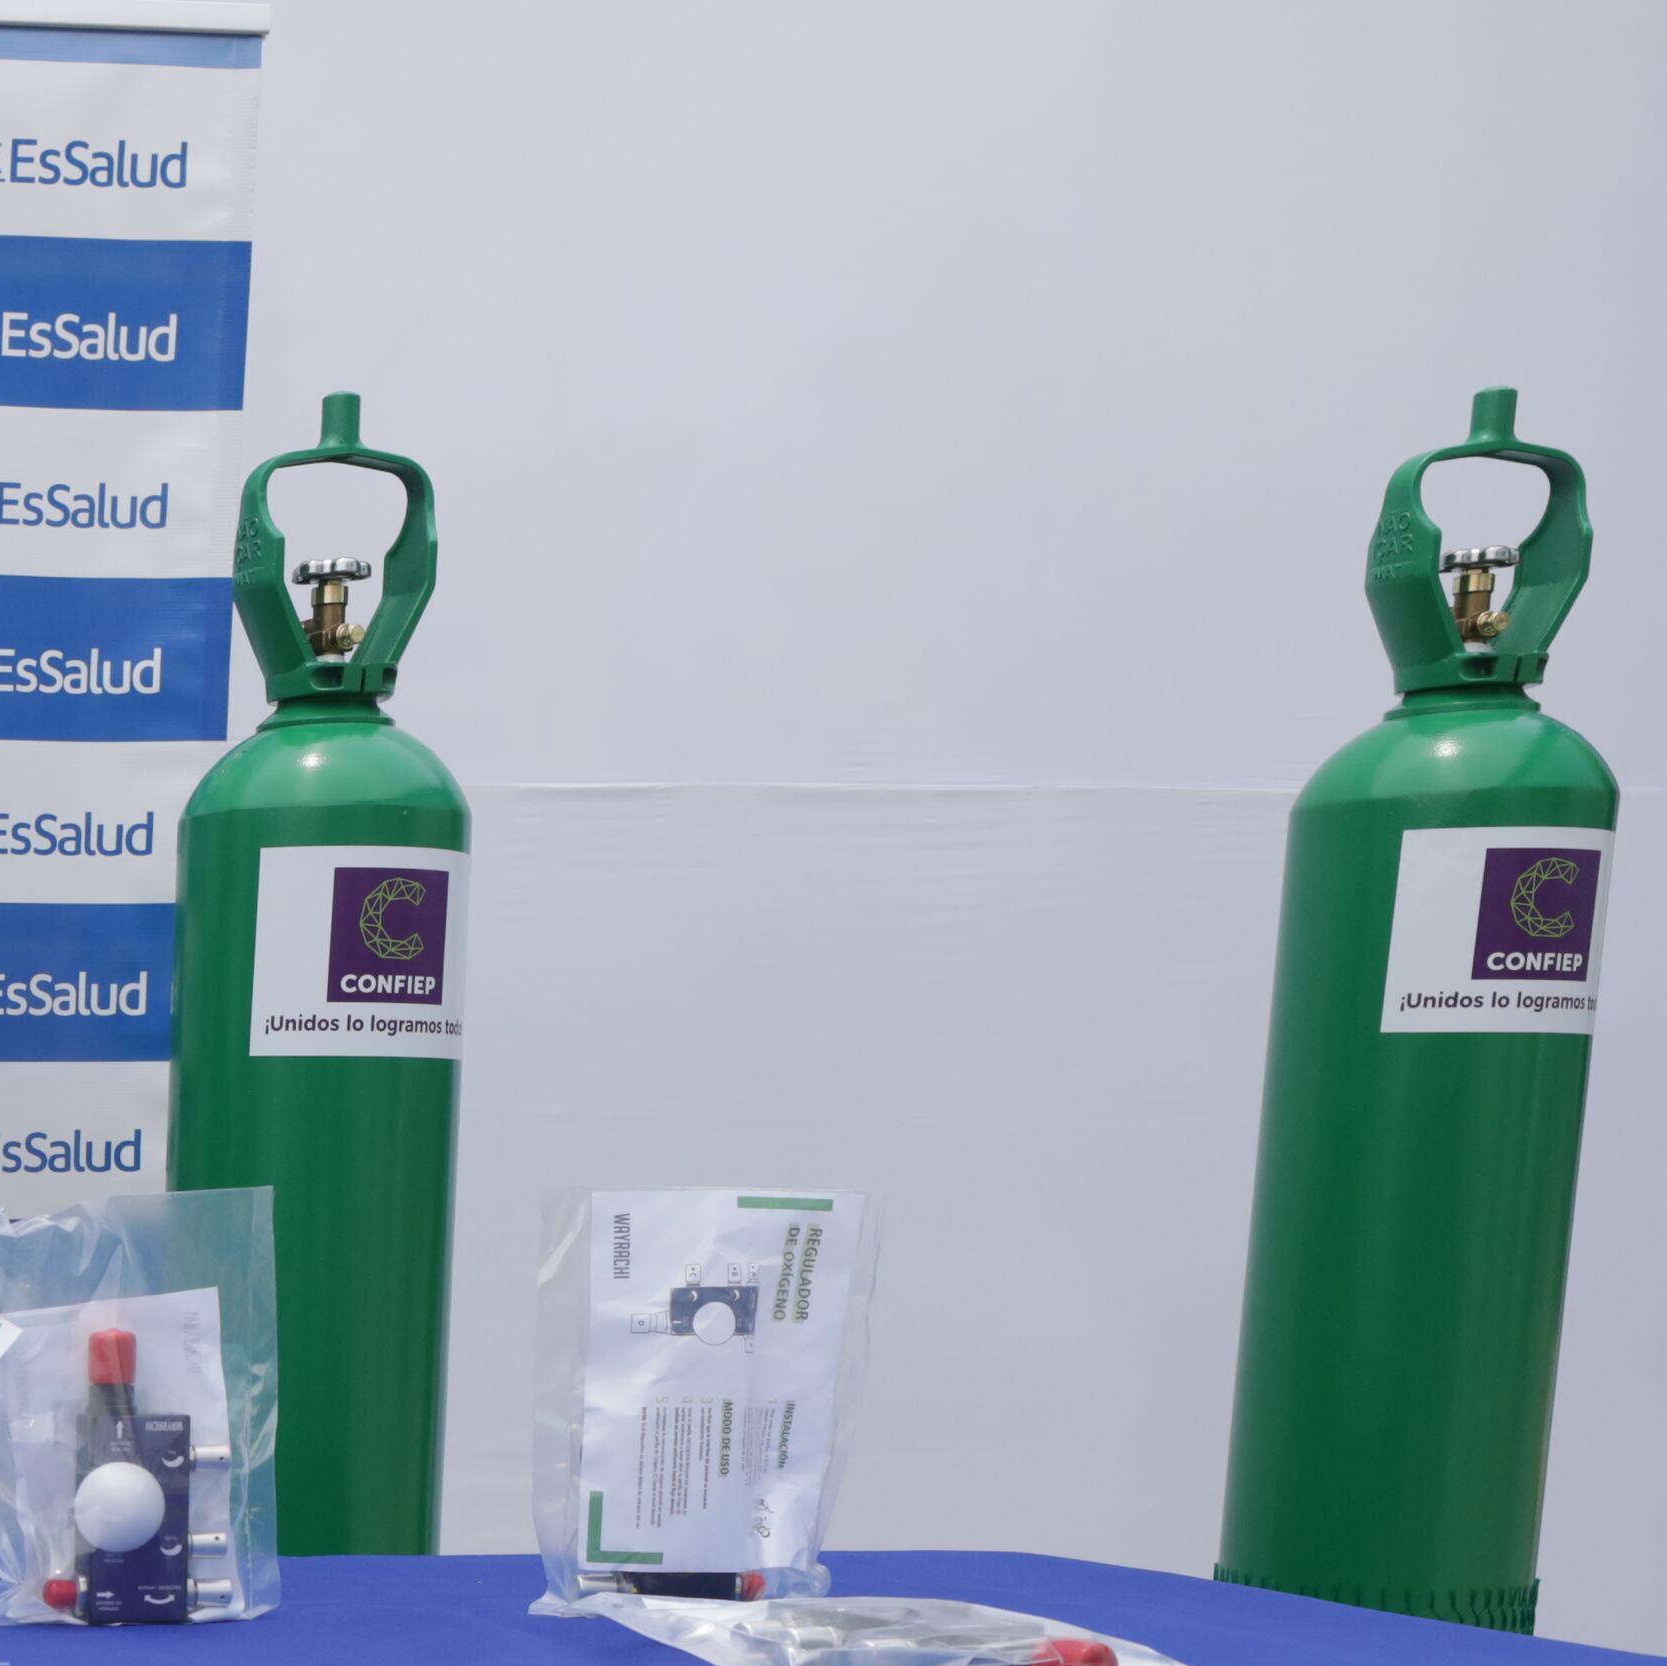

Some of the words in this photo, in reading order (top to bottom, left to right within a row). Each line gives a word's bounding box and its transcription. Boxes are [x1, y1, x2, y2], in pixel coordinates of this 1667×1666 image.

[10, 139, 187, 188] EsSalud
[2, 312, 177, 361] EsSalud
[1486, 951, 1583, 972] CONFIEP
[340, 974, 436, 995] CONFIEP
[1400, 991, 1483, 1012] ¡Unidos
[1491, 991, 1510, 1008] lo
[1516, 991, 1585, 1013] logramos
[265, 1014, 340, 1035] ¡Unidos
[347, 1014, 364, 1032] lo
[370, 1014, 442, 1036] logramos
[445, 1017, 462, 1036] tod
[612, 1213, 630, 1280] WAYRACHI
[787, 1226, 801, 1248] DE
[796, 1227, 823, 1322] REGULADOR
[773, 1251, 796, 1322] OXÍGENO
[721, 1402, 733, 1434] MODO
[720, 1437, 731, 1452] DE
[719, 1453, 730, 1476] USO
